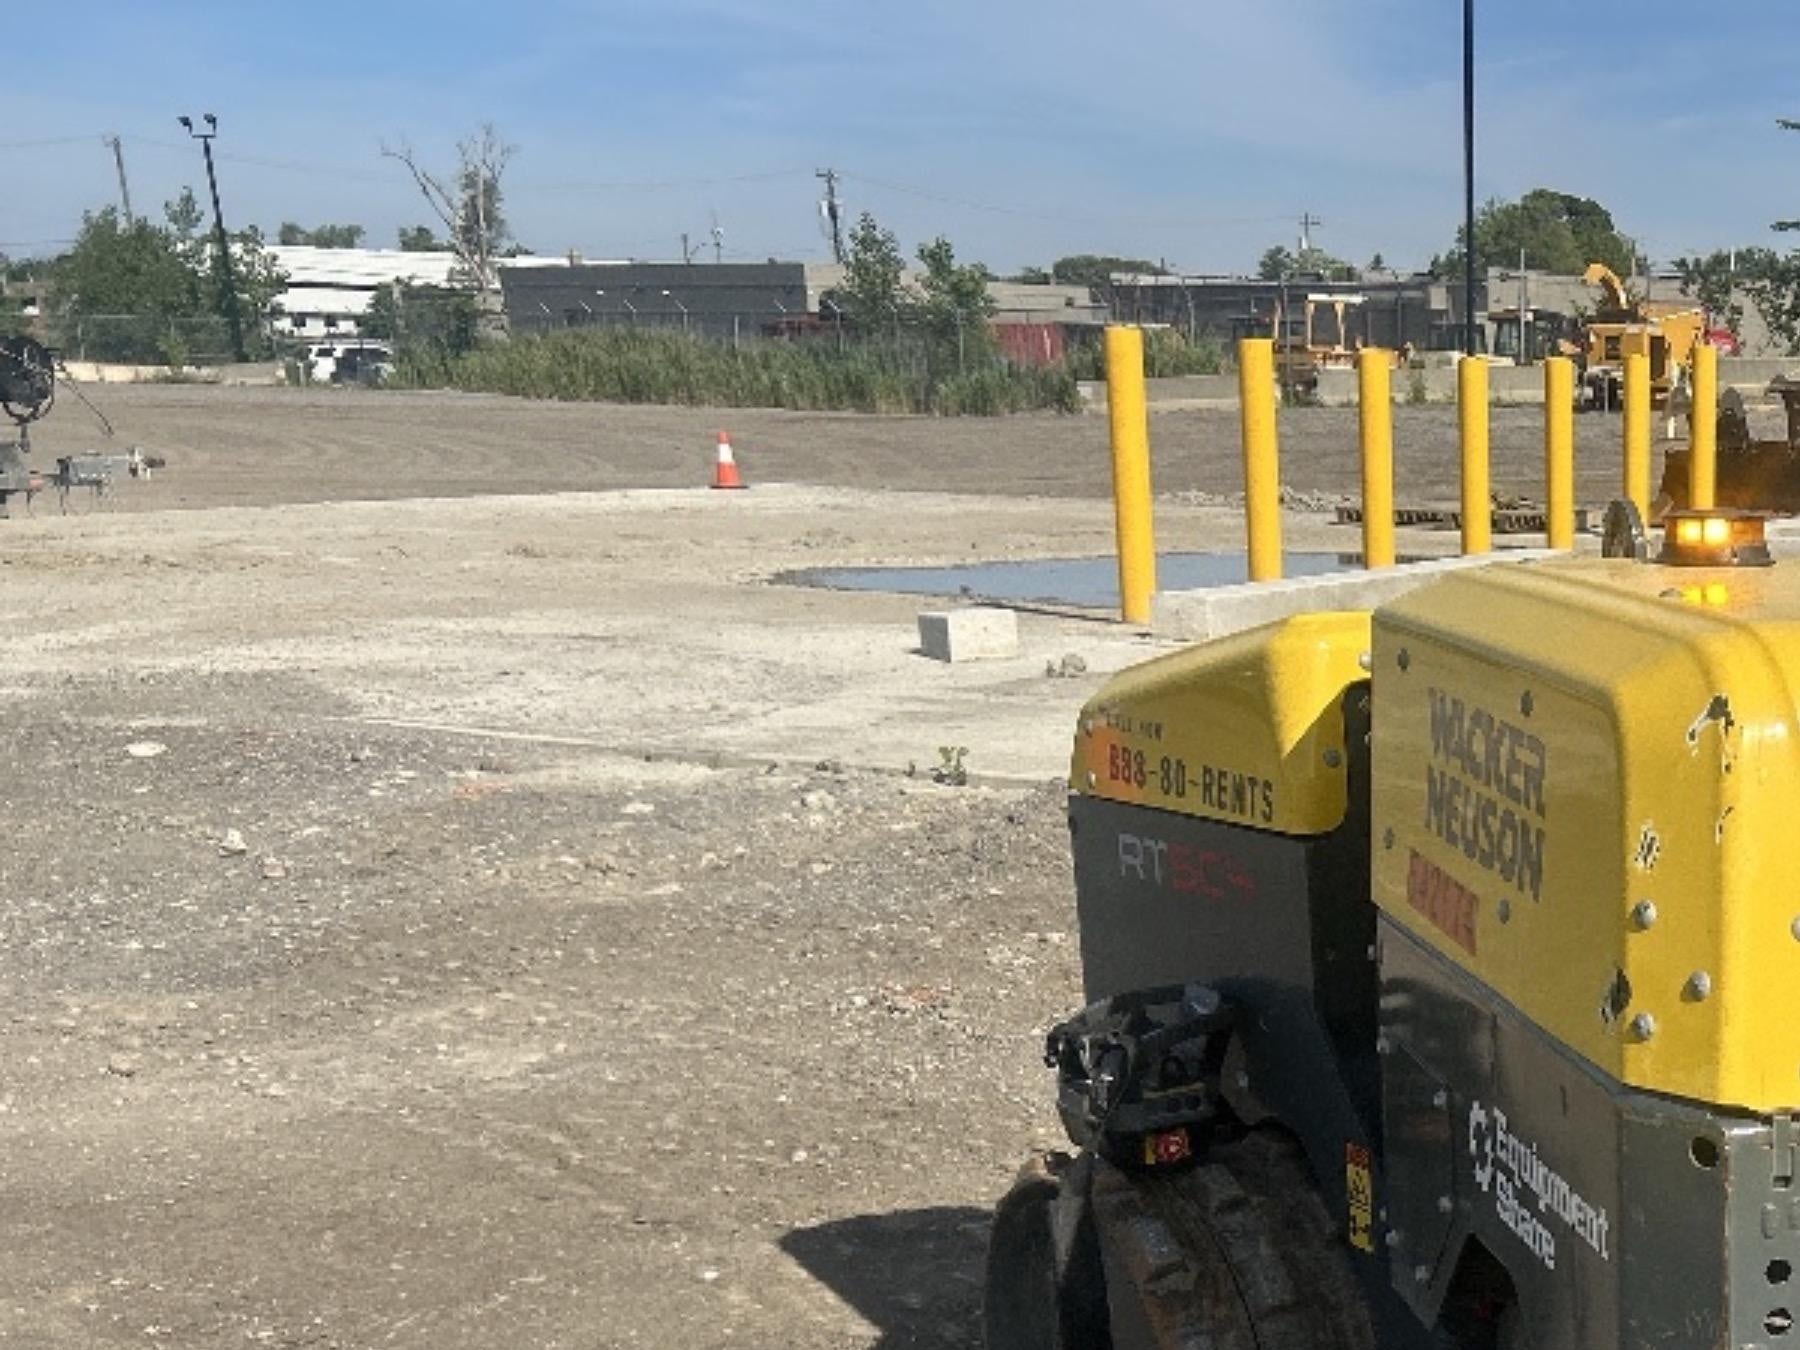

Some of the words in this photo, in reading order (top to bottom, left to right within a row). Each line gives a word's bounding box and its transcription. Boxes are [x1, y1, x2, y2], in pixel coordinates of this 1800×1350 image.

[1427, 686, 1547, 820] WACKER
[1424, 763, 1546, 904] NEUSON
[1493, 1106, 1609, 1261] Equipment
[1496, 1170, 1555, 1270] Share
